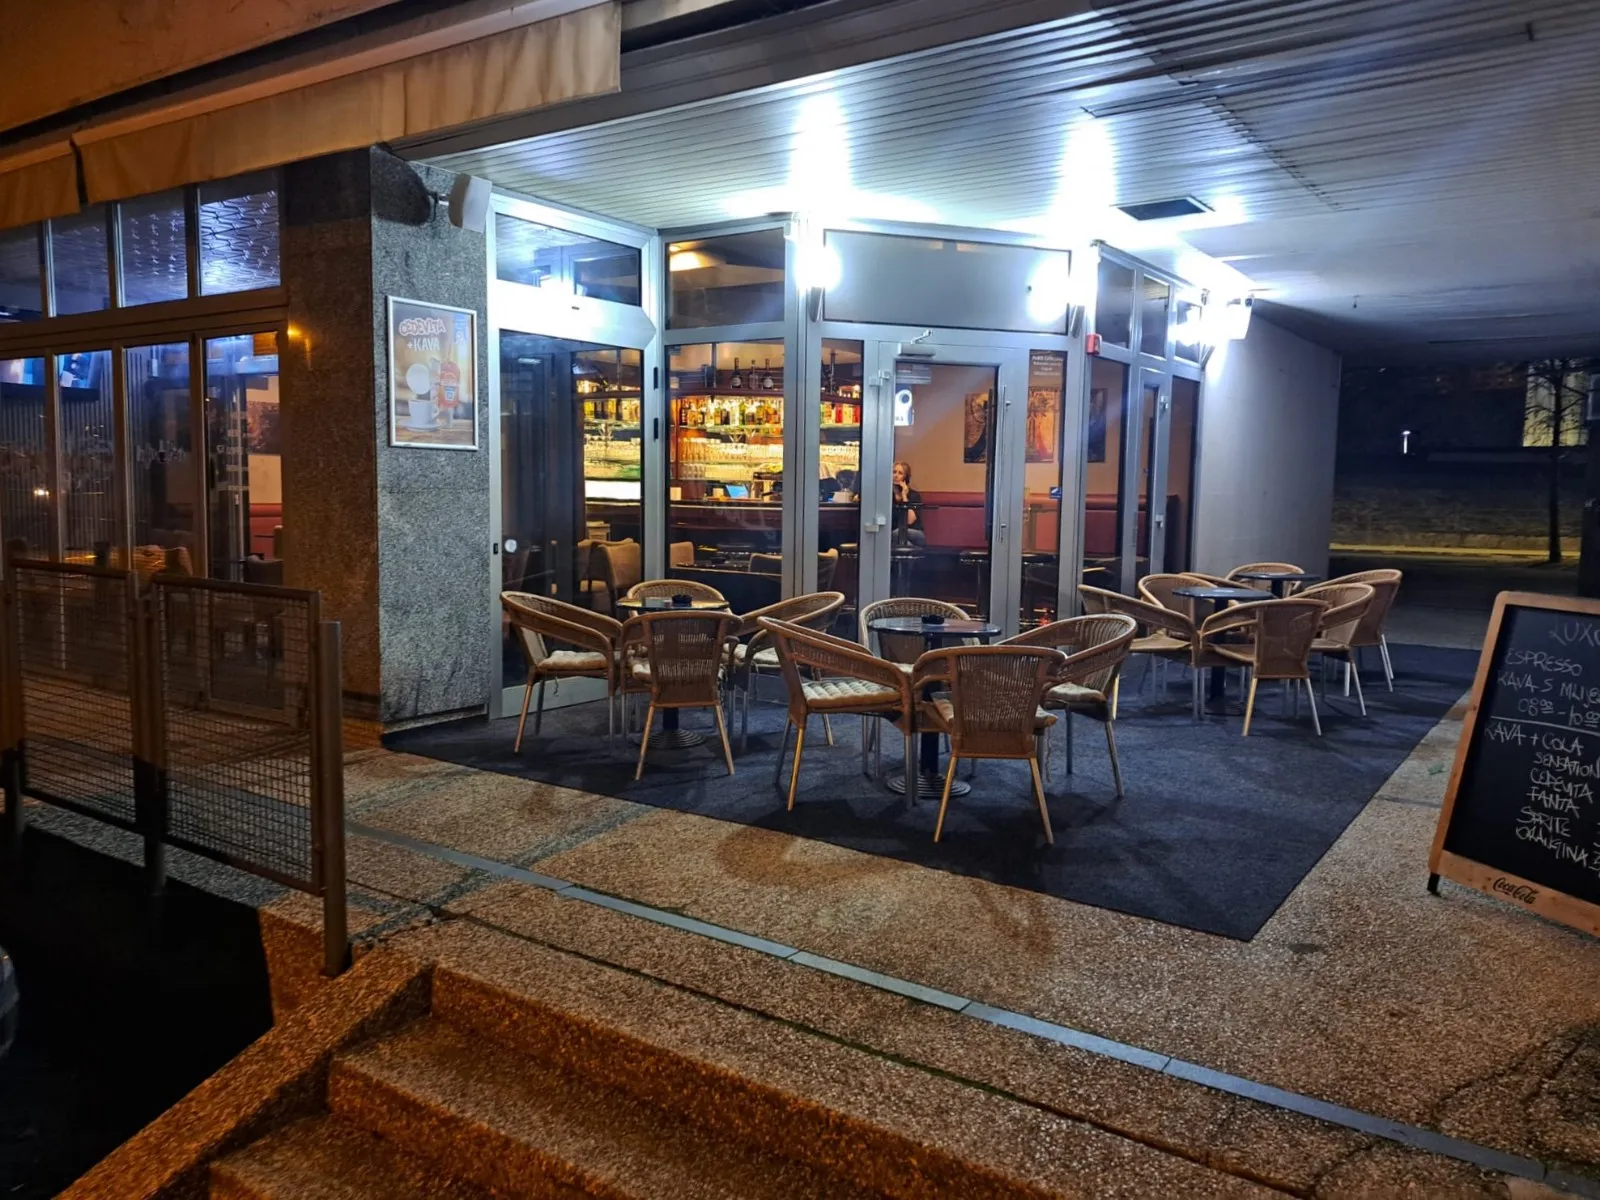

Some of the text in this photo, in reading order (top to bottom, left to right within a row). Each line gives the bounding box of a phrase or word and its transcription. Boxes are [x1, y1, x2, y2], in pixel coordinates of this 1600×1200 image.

[1505, 648, 1583, 677] ESPRESSO
[1542, 731, 1585, 757] COLA
[1526, 786, 1581, 819] FANTA
[1516, 805, 1572, 837] SPRITE
[1516, 826, 1588, 868] ORANGINA
